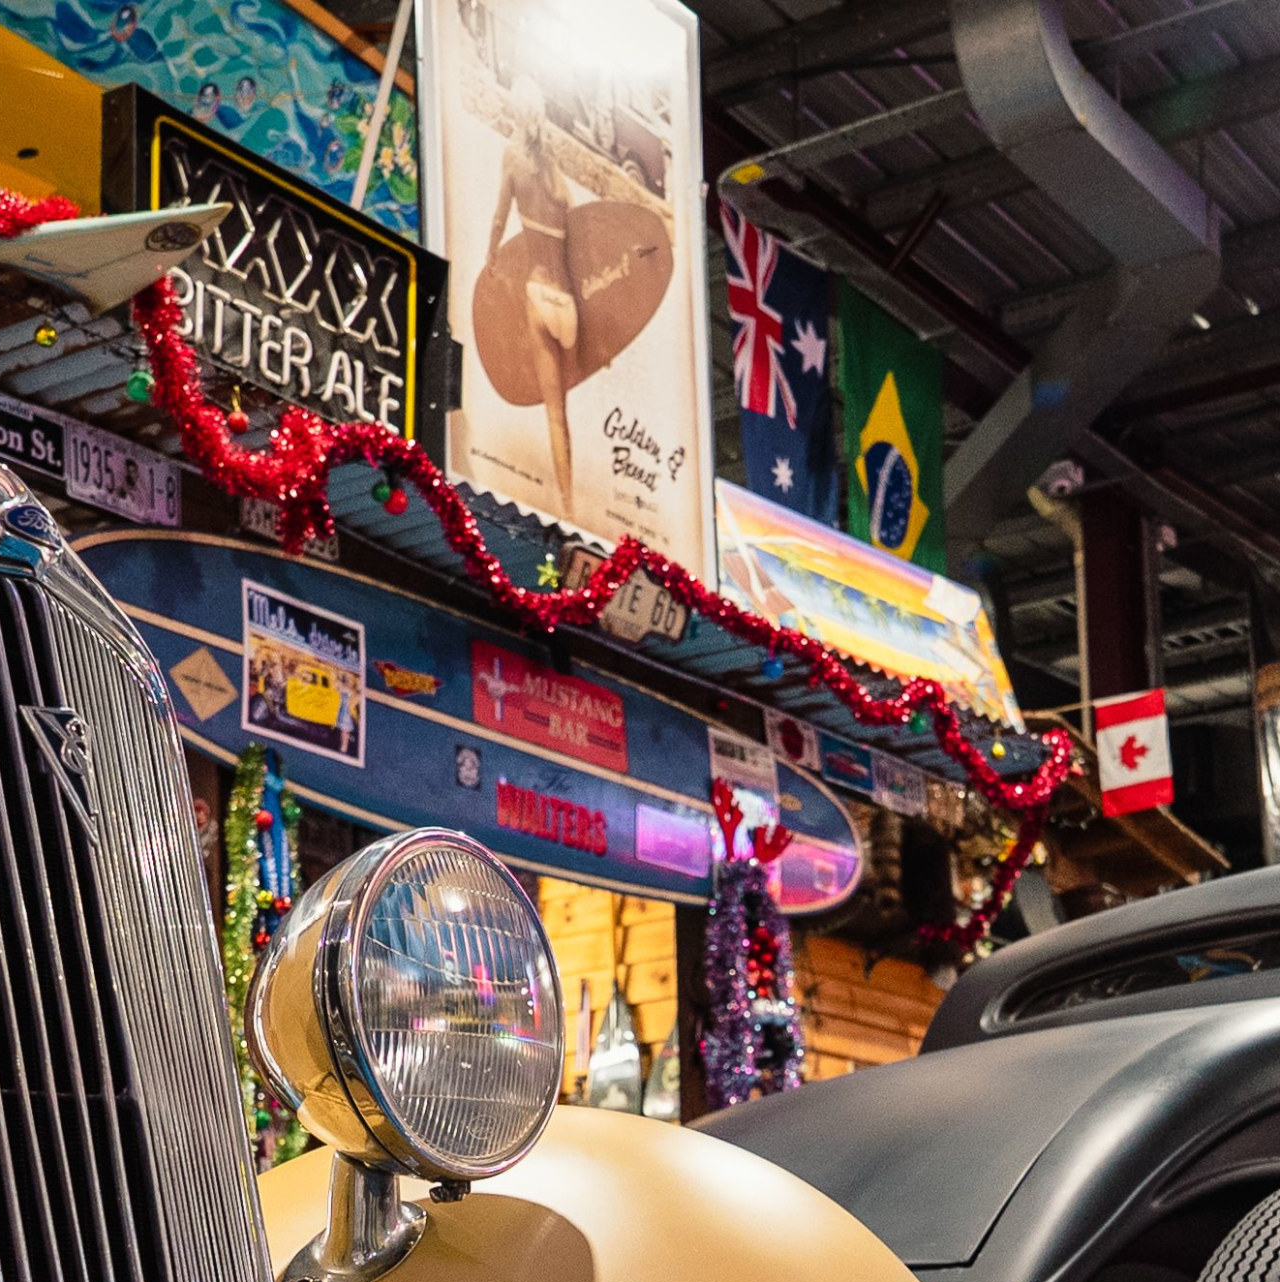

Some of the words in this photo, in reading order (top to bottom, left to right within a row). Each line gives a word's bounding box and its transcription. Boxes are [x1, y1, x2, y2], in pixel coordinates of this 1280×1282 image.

[320, 350, 404, 435] ALE
[30, 428, 63, 468] St.
[72, 436, 116, 495] 1935
[17, 508, 61, 541] Ford
[651, 589, 679, 633] 66
[524, 672, 622, 728] MUSTANG
[548, 712, 591, 748] BAR
